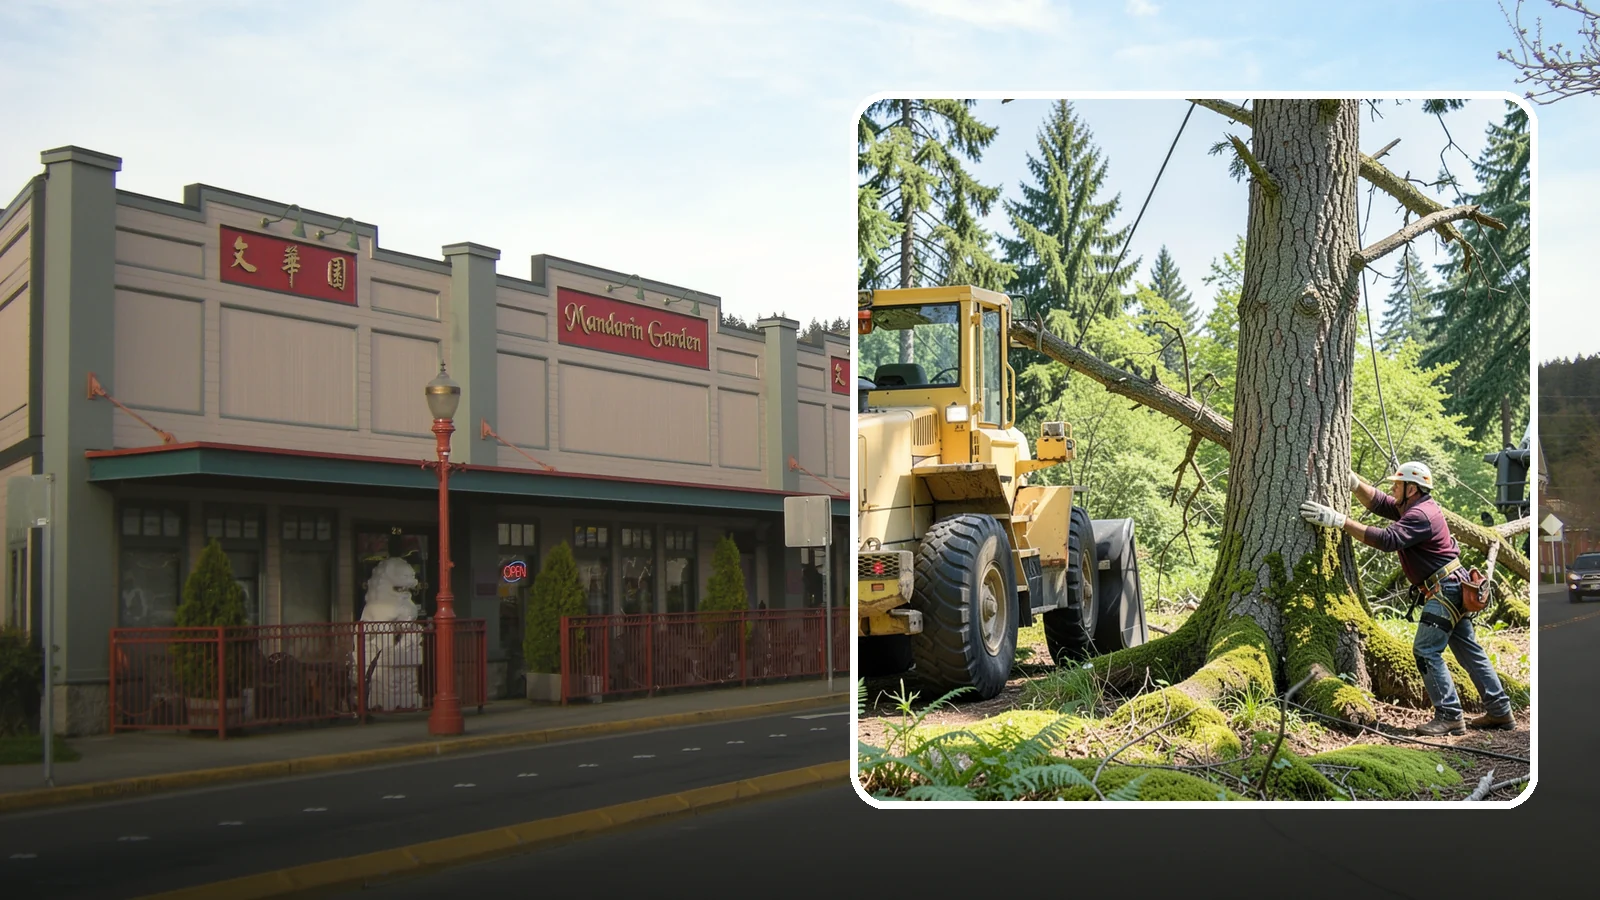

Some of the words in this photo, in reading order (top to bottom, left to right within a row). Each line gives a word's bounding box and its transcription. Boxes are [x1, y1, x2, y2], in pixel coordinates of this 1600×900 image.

[230, 235, 346, 291] 文華園
[564, 302, 644, 341] Mandarin
[647, 320, 702, 352] Garden
[503, 565, 527, 578] OPEN
